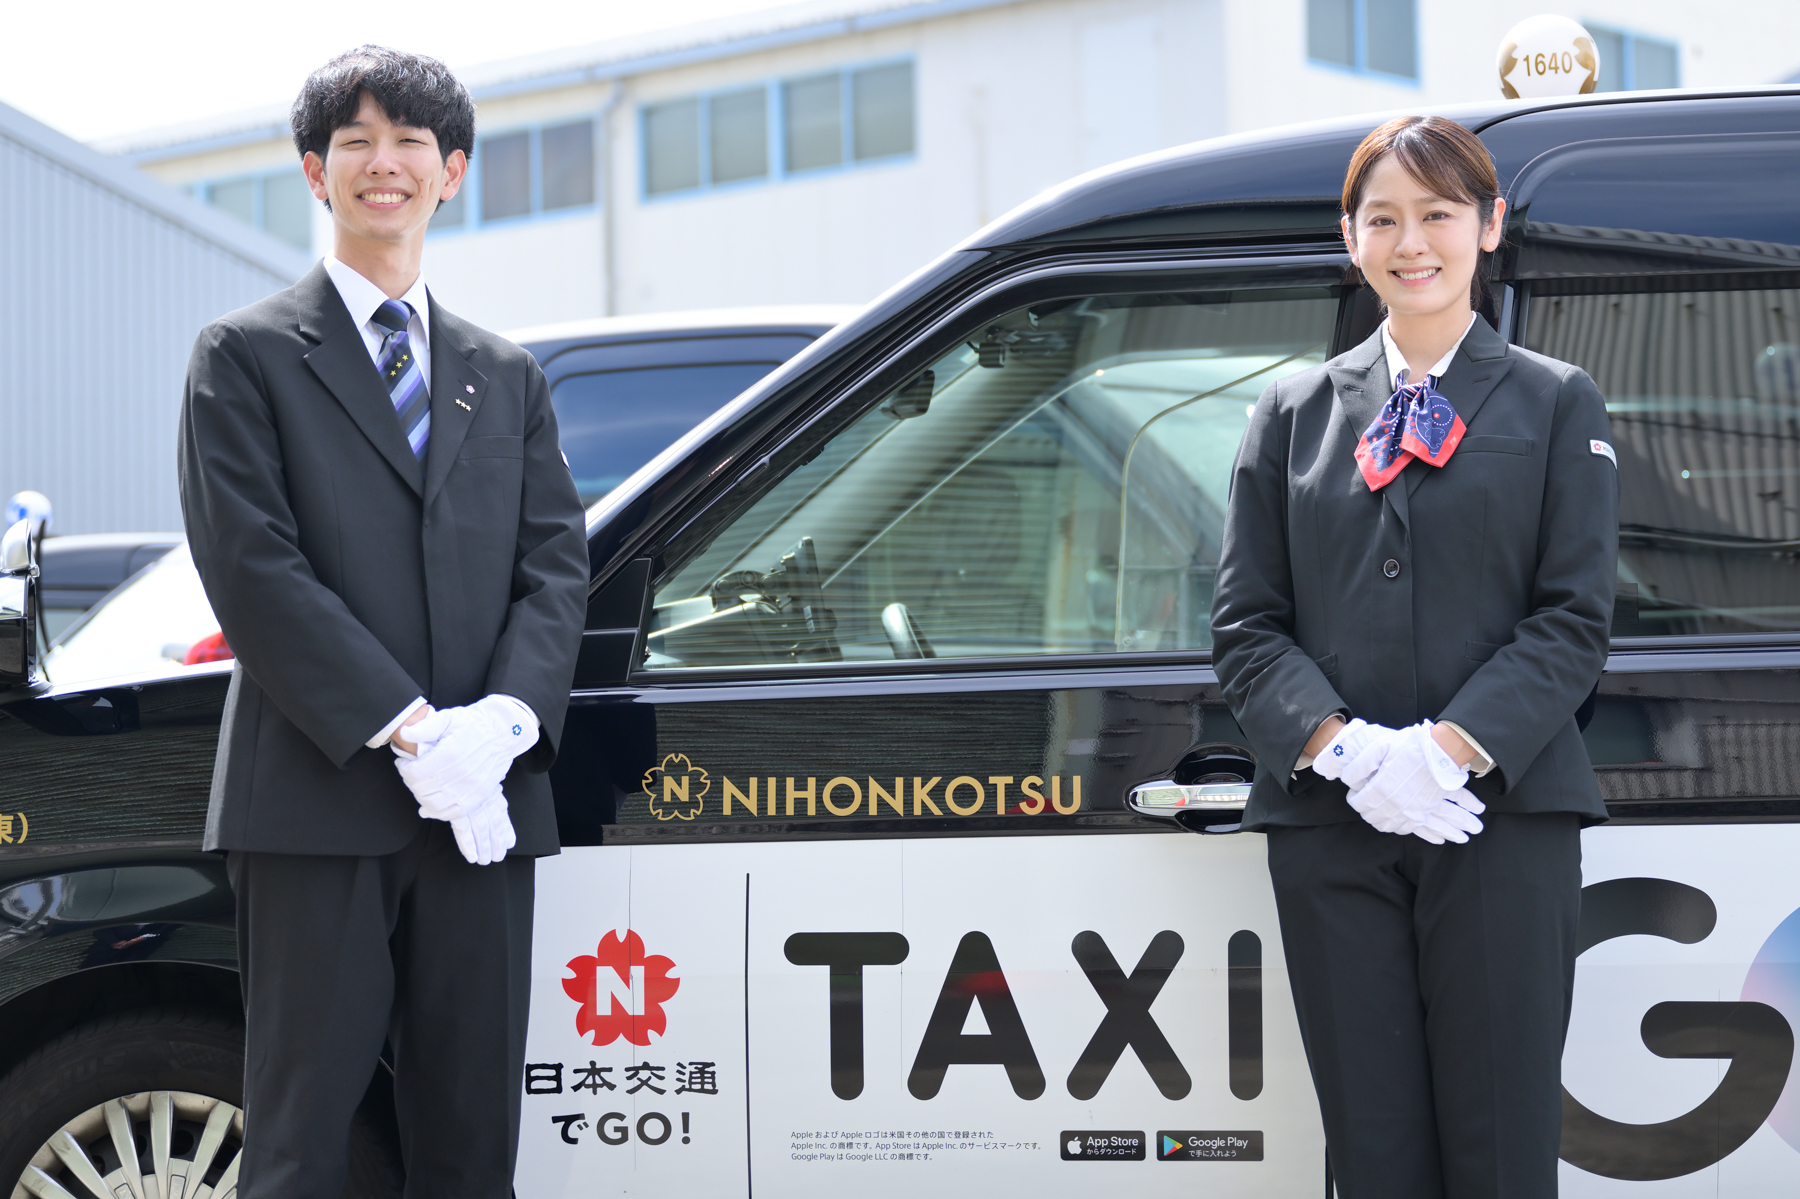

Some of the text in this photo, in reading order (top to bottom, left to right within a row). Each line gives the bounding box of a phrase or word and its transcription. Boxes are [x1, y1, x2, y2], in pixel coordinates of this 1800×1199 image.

[1523, 51, 1573, 77] 1640
[663, 775, 1082, 818] N NIHONKOTSU
[596, 965, 645, 1016] N
[784, 929, 1264, 1101] TAXI
[524, 1060, 719, 1096] 日本交通
[551, 1111, 691, 1146] でGO!
[790, 1130, 995, 1140] Apple および Apple ロゴは米国その他の国で登録された
[790, 1142, 814, 1151] Apple
[875, 1142, 891, 1151] App
[892, 1142, 912, 1150] Store
[922, 1142, 944, 1151] Apple
[959, 1142, 1042, 1150] のサービスマークです。
[1086, 1136, 1139, 1147] App Store
[1188, 1136, 1249, 1149] Google Play
[790, 1152, 819, 1162] Google
[819, 1152, 835, 1162] Play
[836, 1152, 844, 1161] は
[845, 1152, 874, 1162] Google
[874, 1152, 889, 1161] LLC
[1086, 1148, 1137, 1156] からダウンロード
[1188, 1148, 1238, 1158] で手に入れよう
